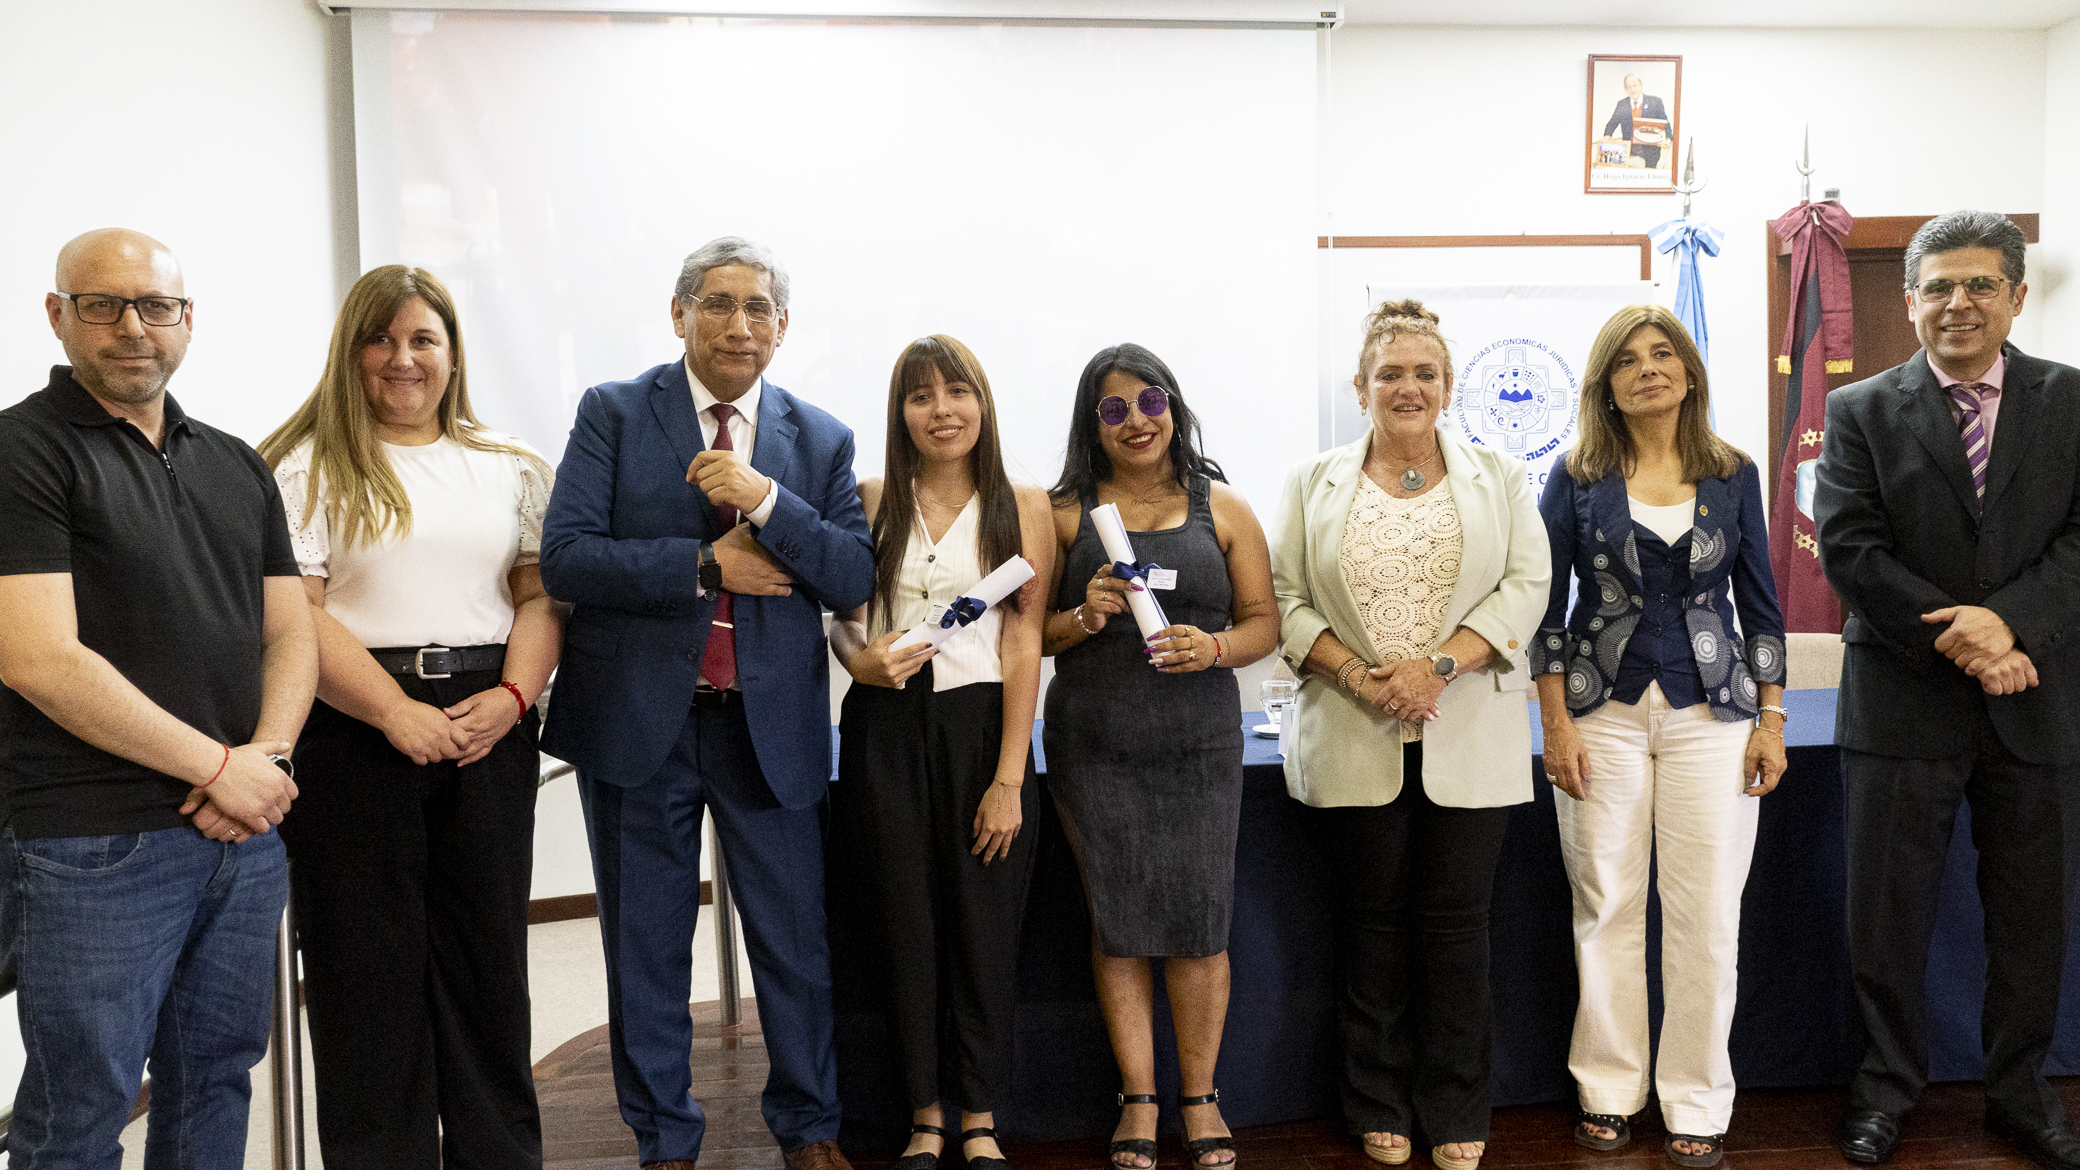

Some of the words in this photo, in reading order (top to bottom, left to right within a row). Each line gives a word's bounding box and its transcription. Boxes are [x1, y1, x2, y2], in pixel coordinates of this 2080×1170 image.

[1491, 338, 1548, 352] ECONOMICAS
[1461, 346, 1491, 380] CIENCIAS
[1547, 350, 1578, 389] JURIDICAS
[1457, 381, 1466, 394] DE
[1560, 397, 1580, 440] SOCIALES
